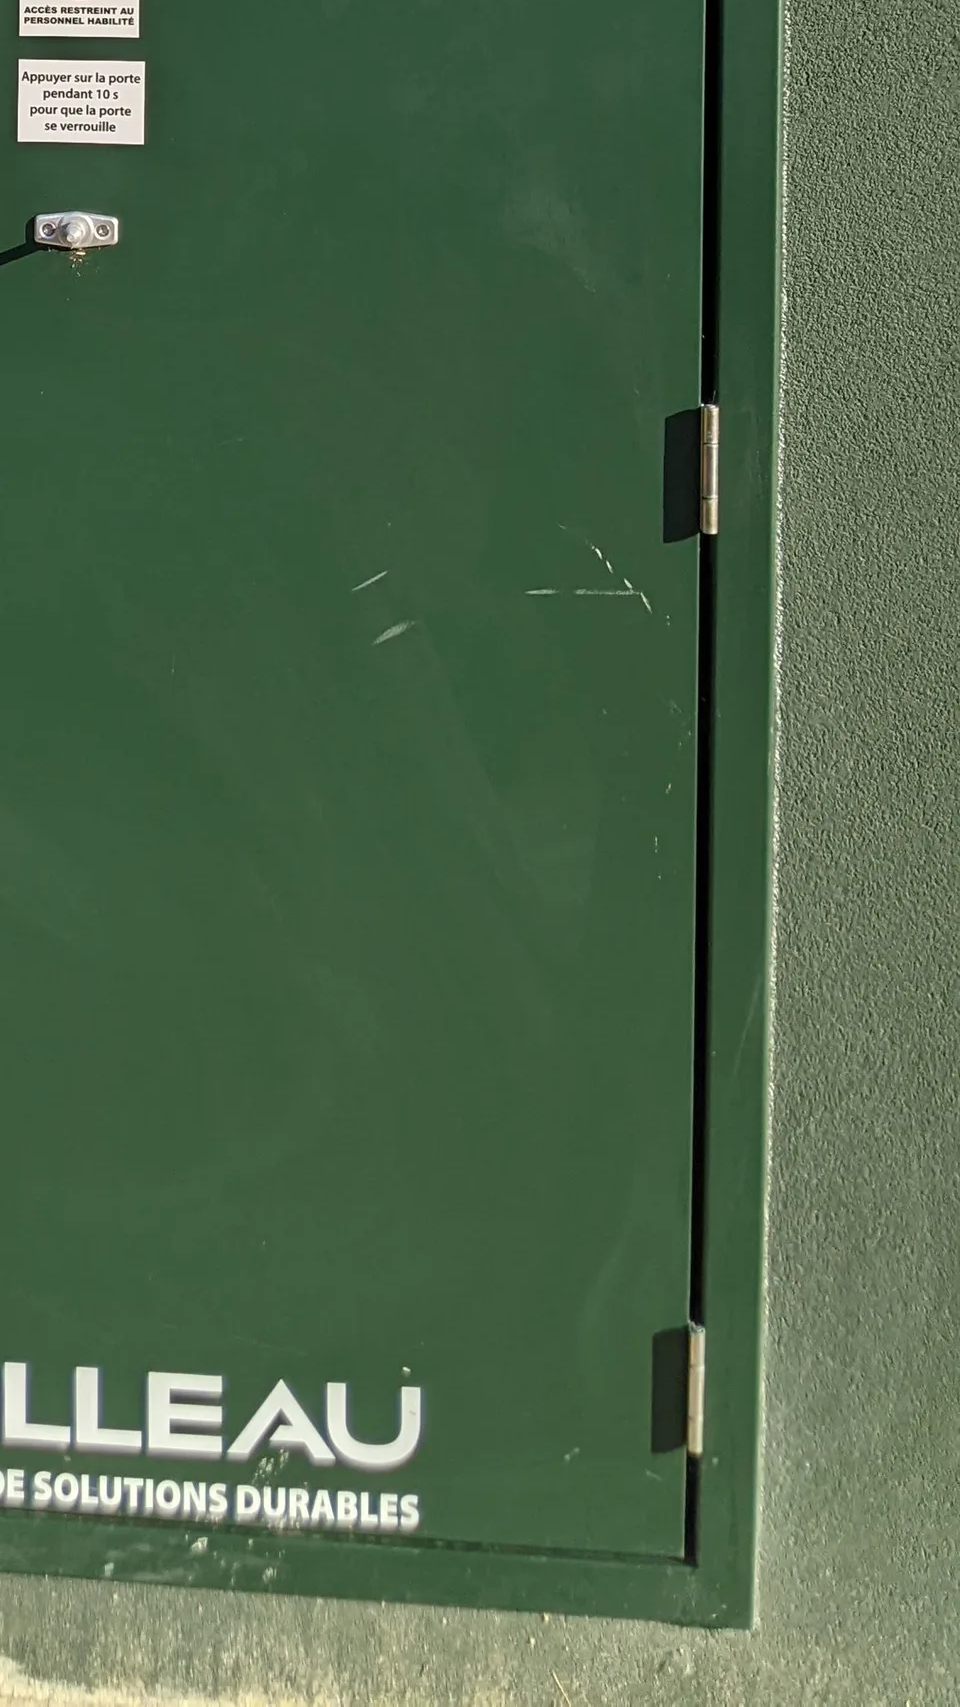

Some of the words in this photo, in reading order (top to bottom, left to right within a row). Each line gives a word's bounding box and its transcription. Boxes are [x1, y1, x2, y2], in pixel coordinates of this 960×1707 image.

[23, 5, 57, 14] ACCÈS
[60, 6, 117, 14] RESTREINT
[23, 16, 84, 24] PERSONNEL
[87, 16, 134, 25] HABILITÉ
[21, 71, 71, 84] Appuyer
[74, 74, 93, 82] sur
[95, 72, 105, 82] la
[108, 74, 140, 85] porte
[43, 87, 93, 100] pendant
[96, 89, 110, 99] 10
[112, 91, 118, 99] s
[29, 106, 58, 117] pour
[60, 106, 83, 117] que
[85, 104, 96, 115] la
[99, 106, 131, 118] porte
[44, 122, 57, 130] se
[59, 121, 116, 132] verrouille
[34, 1470, 227, 1520] SOLUTIONS
[236, 1484, 419, 1527] DURABLES
